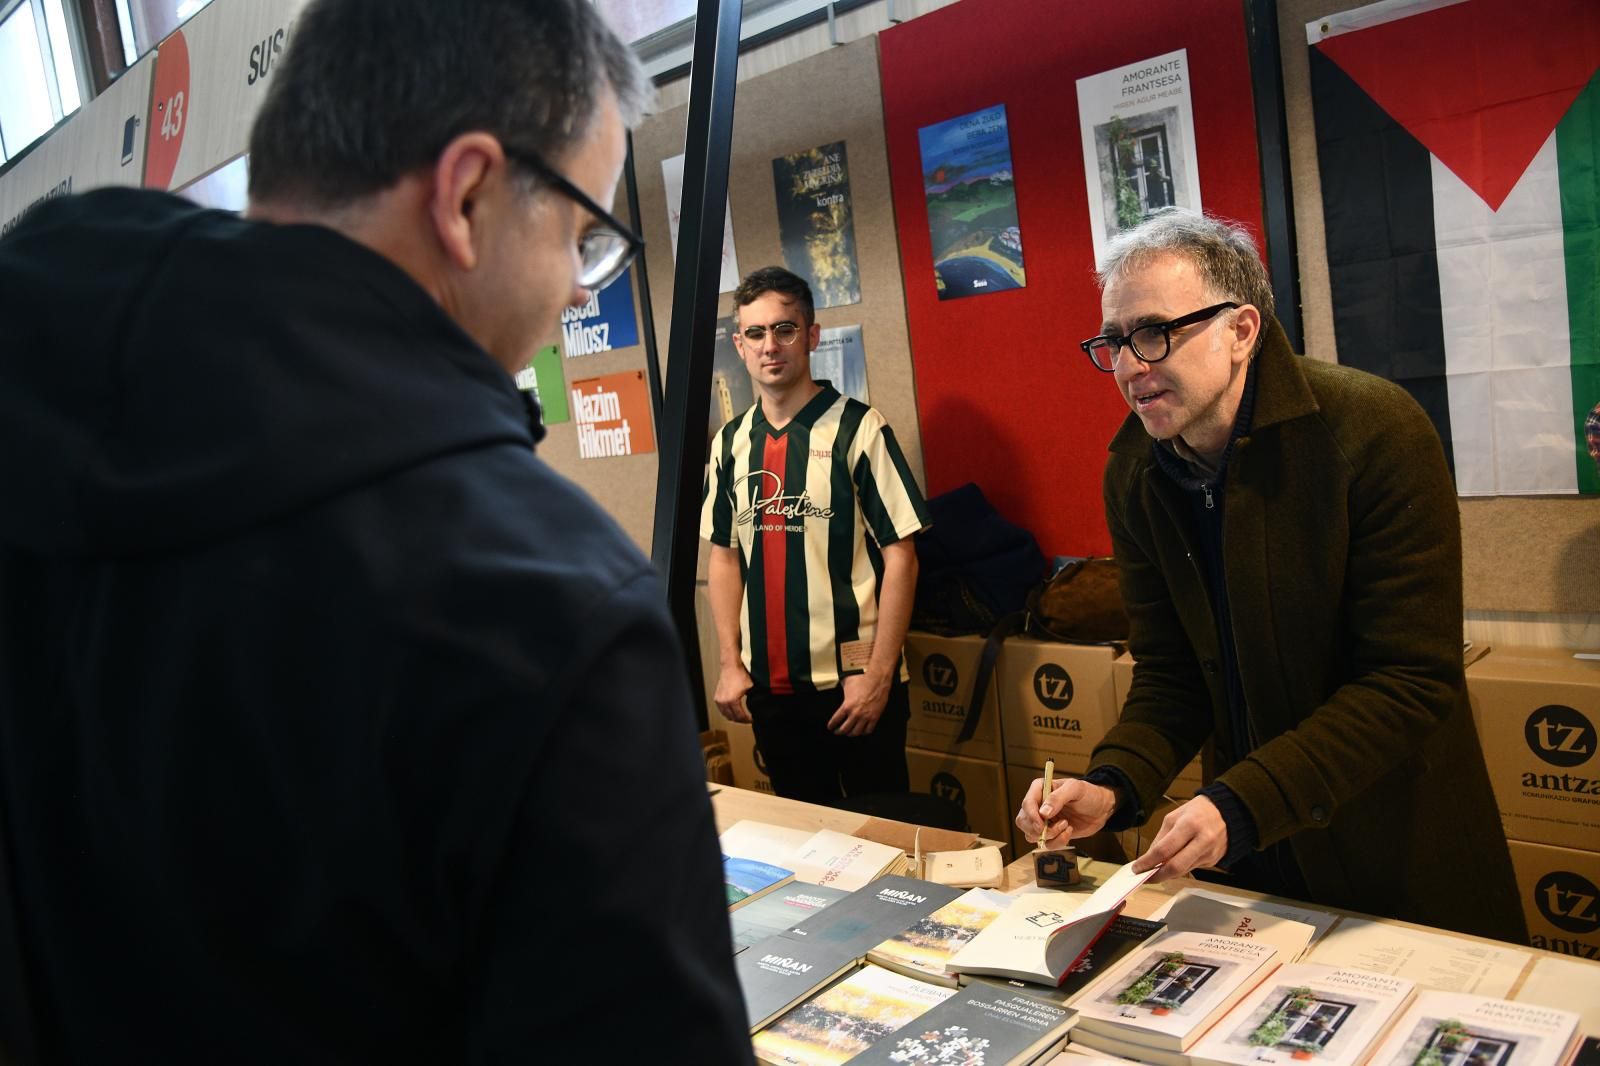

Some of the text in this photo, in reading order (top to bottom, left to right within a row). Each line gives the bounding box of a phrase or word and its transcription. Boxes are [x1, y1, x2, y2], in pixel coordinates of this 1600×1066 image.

[1122, 59, 1181, 84] AMORANTE
[1121, 73, 1182, 97] FRANTSESA
[160, 91, 185, 142] 43
[816, 193, 845, 208] kontra
[562, 322, 613, 359] Milosz
[571, 385, 622, 424] Nazim
[576, 419, 632, 460] Hikmet
[727, 469, 835, 527] Palestine
[755, 523, 774, 532] LAND
[774, 524, 784, 532] OF
[928, 663, 954, 688] tz
[1038, 673, 1069, 700] tz
[922, 700, 966, 717] antza
[1033, 714, 1082, 732] antza
[1533, 717, 1587, 753] tz
[1522, 791, 1571, 802] KOMUNIKAZIO
[879, 888, 928, 904] MIÑAN
[1543, 882, 1597, 922] tz
[1205, 937, 1266, 952] AMORANTE
[760, 954, 814, 973] MIÑAN
[967, 999, 1049, 1027] BOSGARREN ARIMA
[994, 999, 1059, 1021] PASQUALEREN
[1011, 996, 1066, 1015] FRANCESCO
